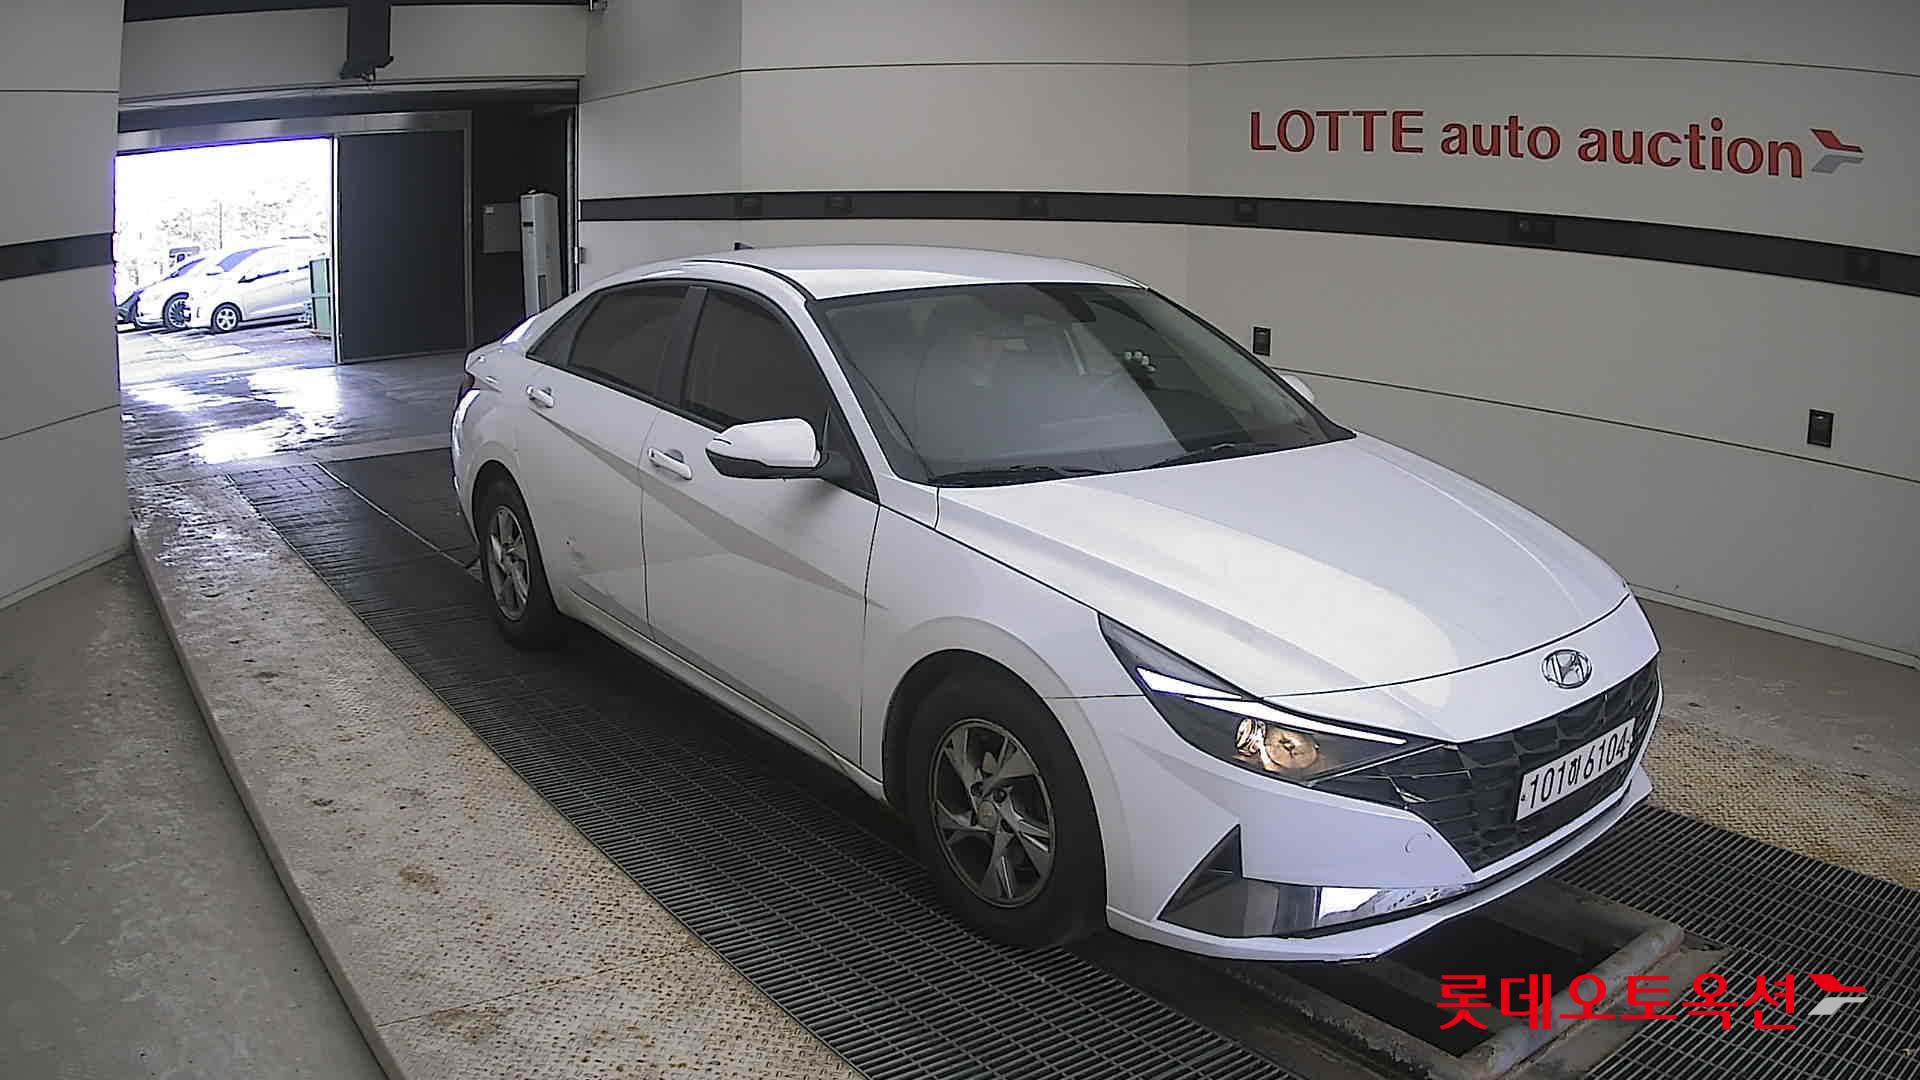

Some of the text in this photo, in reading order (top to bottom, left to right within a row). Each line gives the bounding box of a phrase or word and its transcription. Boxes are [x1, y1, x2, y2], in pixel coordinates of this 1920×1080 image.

[1249, 109, 1803, 179] LOTTE auto auction
